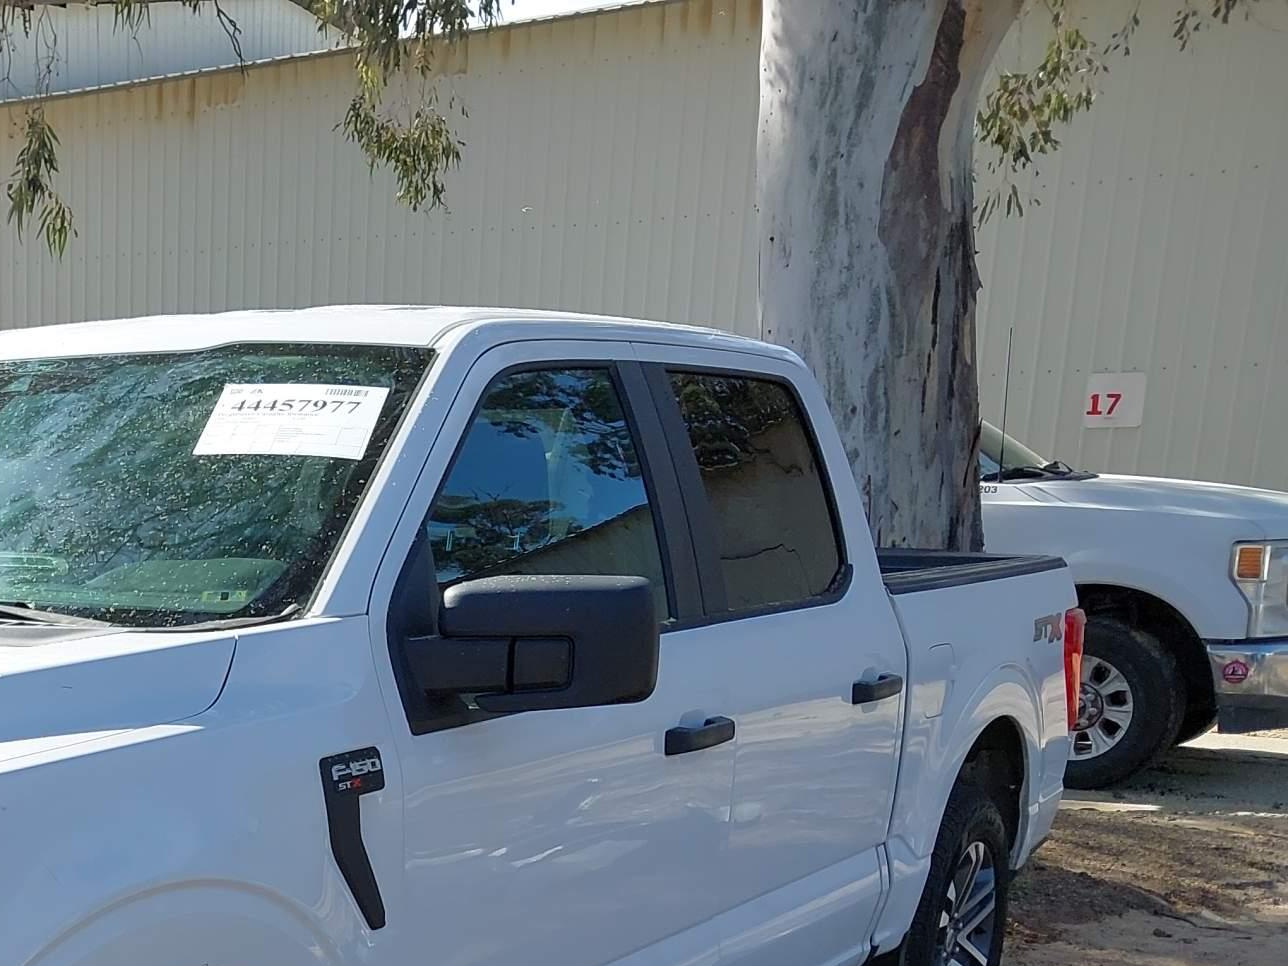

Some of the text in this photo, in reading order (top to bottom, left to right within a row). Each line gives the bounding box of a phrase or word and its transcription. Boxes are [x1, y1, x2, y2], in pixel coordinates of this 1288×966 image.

[231, 399, 363, 414] 44457977
[1086, 393, 1122, 416] 17
[1033, 612, 1062, 644] STX
[332, 758, 381, 781] F-150
[338, 778, 361, 791] STX
